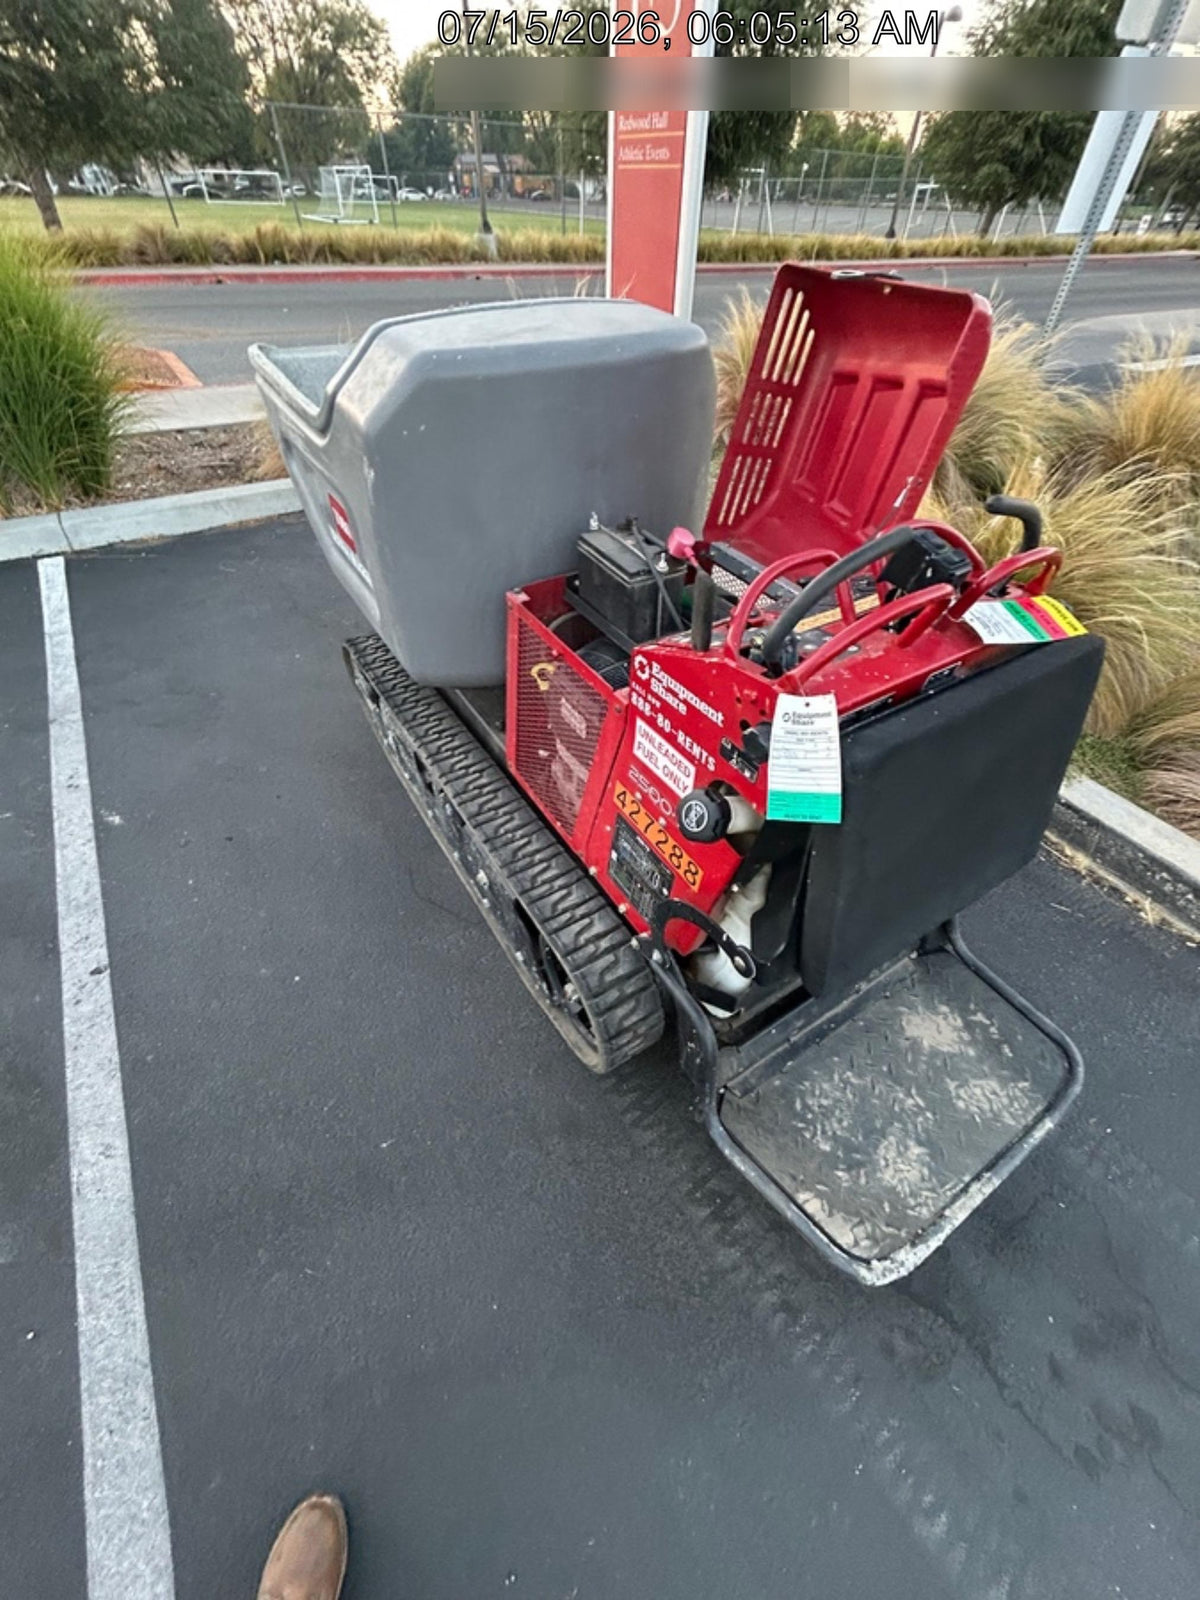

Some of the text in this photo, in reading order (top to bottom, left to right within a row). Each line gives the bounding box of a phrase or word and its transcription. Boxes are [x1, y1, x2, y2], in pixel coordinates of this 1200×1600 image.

[618, 111, 668, 131] Redwood Hall
[618, 144, 670, 161] Athletic Events
[650, 677, 687, 715] Share
[651, 661, 724, 728] Equipment
[791, 711, 832, 721] Equipment
[637, 741, 689, 794] FUEL ONLY
[638, 725, 692, 778] UNLEADED
[616, 789, 700, 887] 427288
